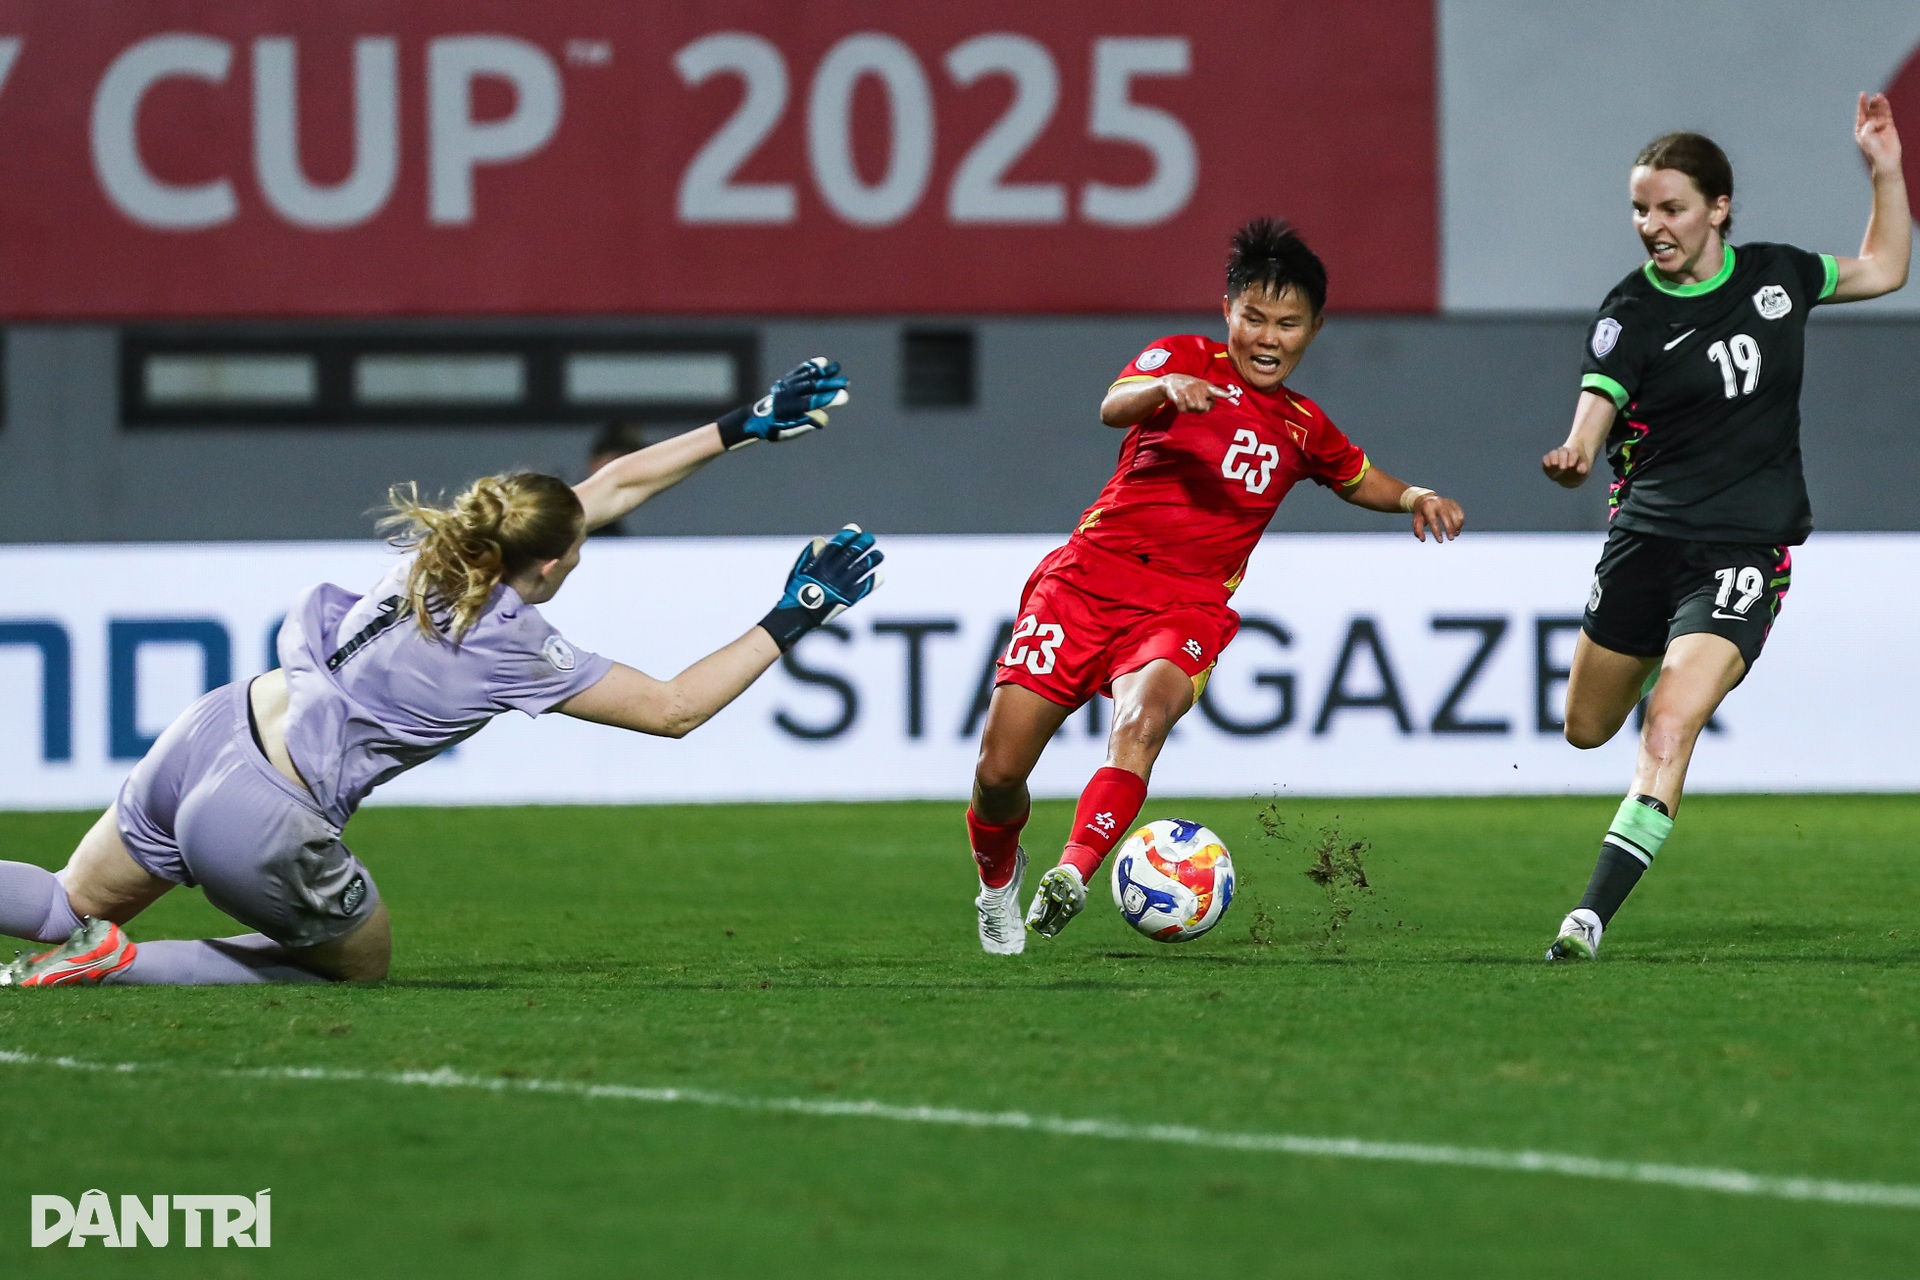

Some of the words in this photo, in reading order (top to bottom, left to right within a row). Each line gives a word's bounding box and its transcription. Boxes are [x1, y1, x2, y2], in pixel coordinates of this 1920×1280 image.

[90, 32, 564, 230] CUP
[673, 31, 1199, 229] 2025
[1707, 333, 1762, 399] 19
[1221, 428, 1280, 494] 23
[1714, 566, 1764, 614] 19
[1004, 613, 1065, 675] 23
[772, 615, 1726, 742] STGAZE
